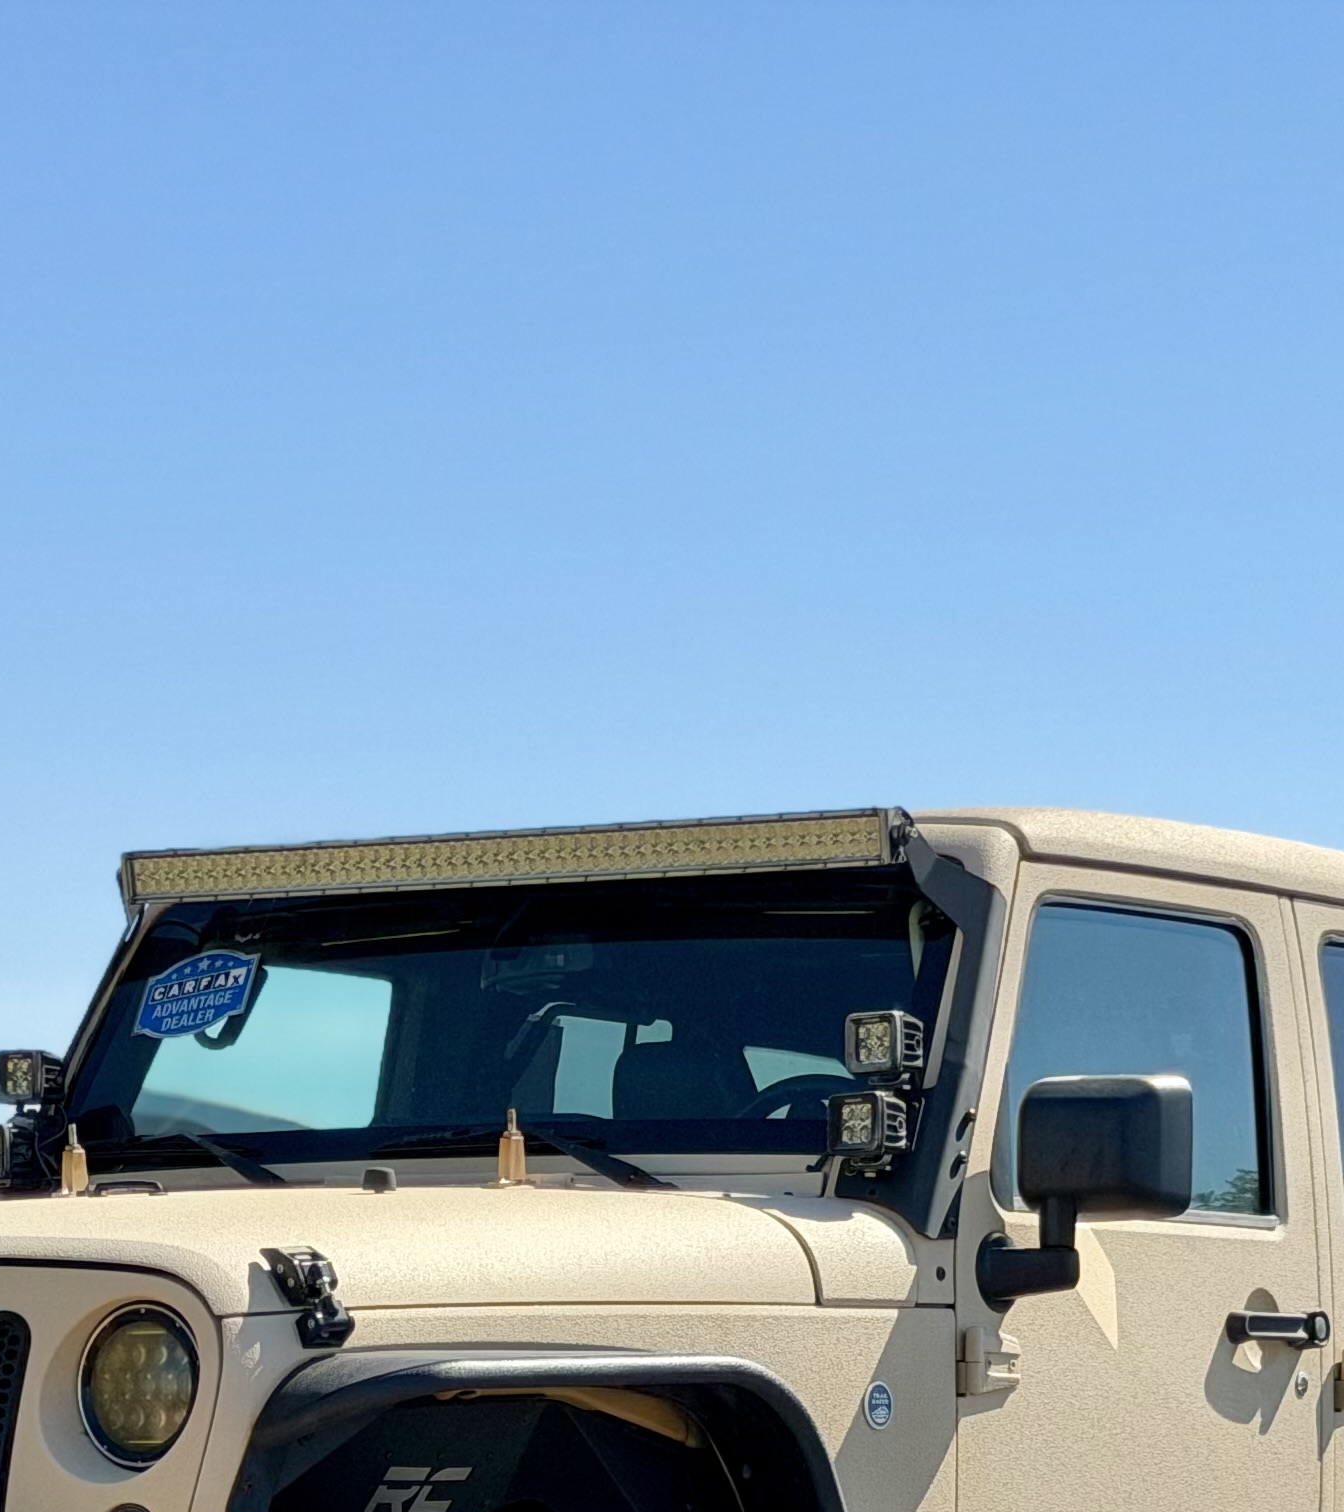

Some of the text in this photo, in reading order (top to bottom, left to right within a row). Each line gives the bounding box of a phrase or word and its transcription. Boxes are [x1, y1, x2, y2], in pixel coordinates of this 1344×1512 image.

[152, 971, 244, 1001] CARFAX
[152, 989, 233, 1019] ADVANTAGE
[161, 1008, 214, 1032] DEALER
